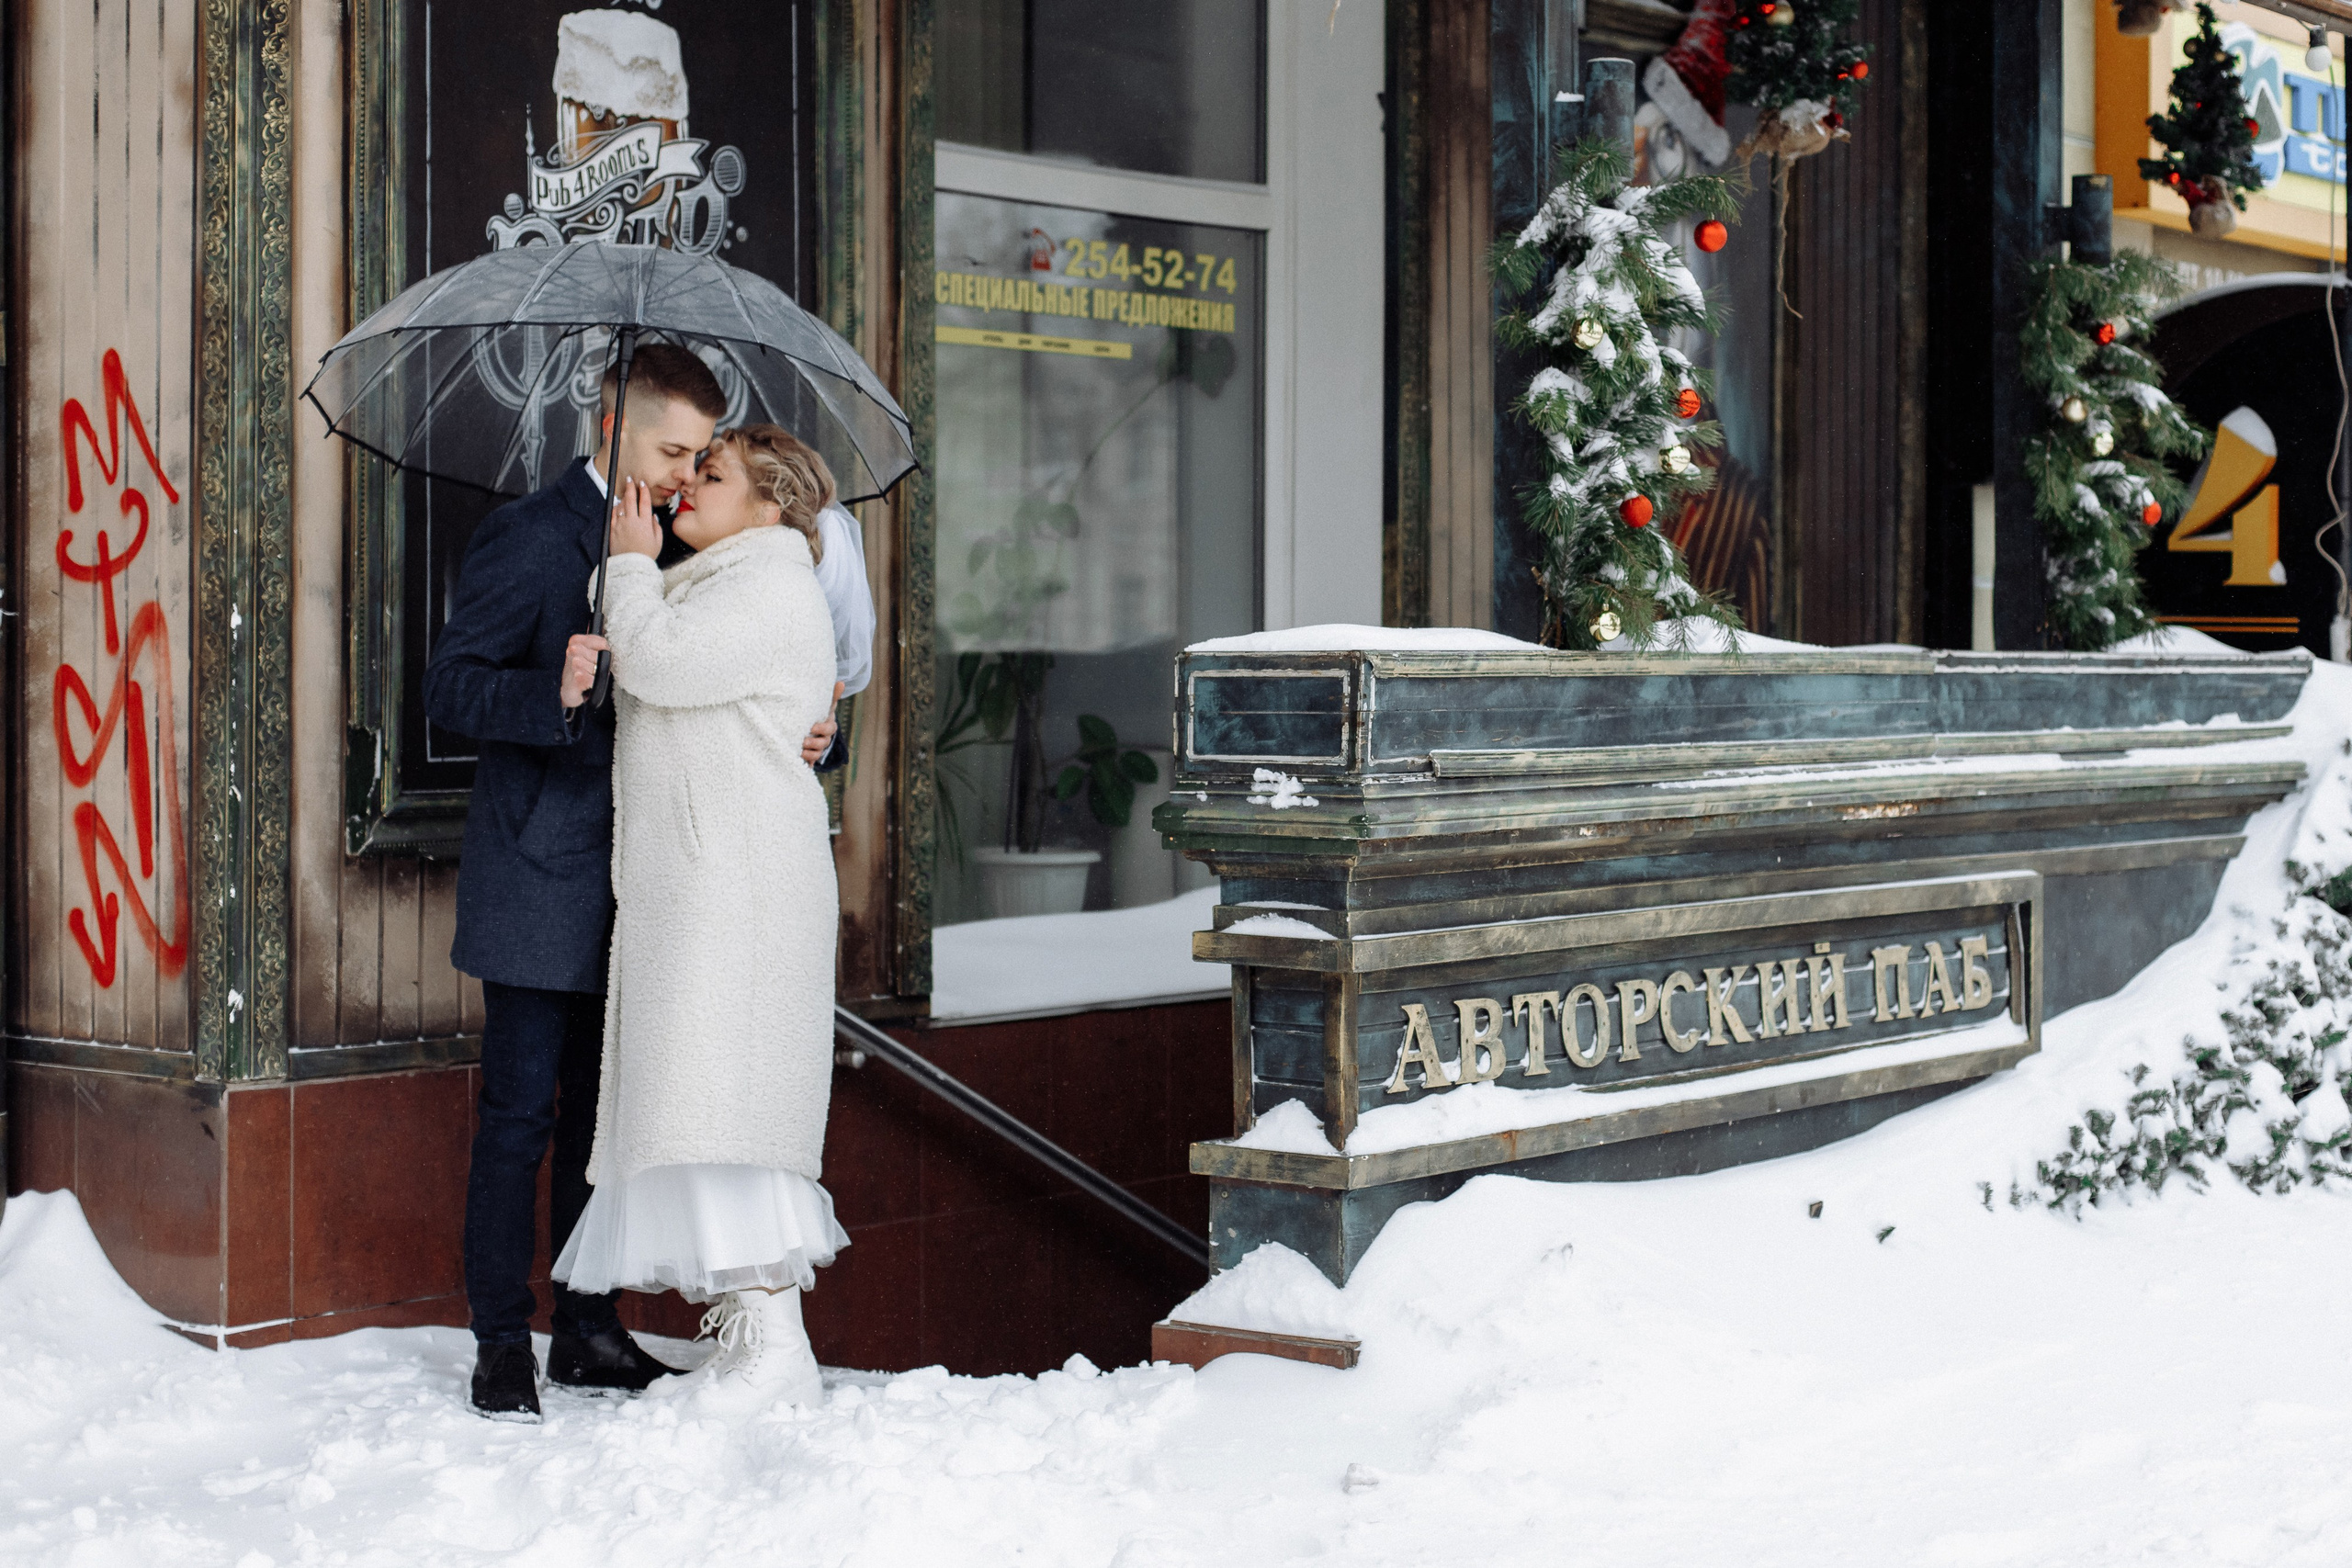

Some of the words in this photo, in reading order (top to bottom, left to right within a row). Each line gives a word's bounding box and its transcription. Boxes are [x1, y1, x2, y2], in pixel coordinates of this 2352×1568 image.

[1065, 237, 1237, 294] 254-52-74
[934, 271, 1090, 318] СПЕЦИАЛЬНЫЕ
[1093, 288, 1235, 333] ПРЕДЛОЖЕНИЯ
[1387, 942, 1852, 1094] АВТОРСКИЙ
[1871, 932, 1993, 1023] ПАБ
